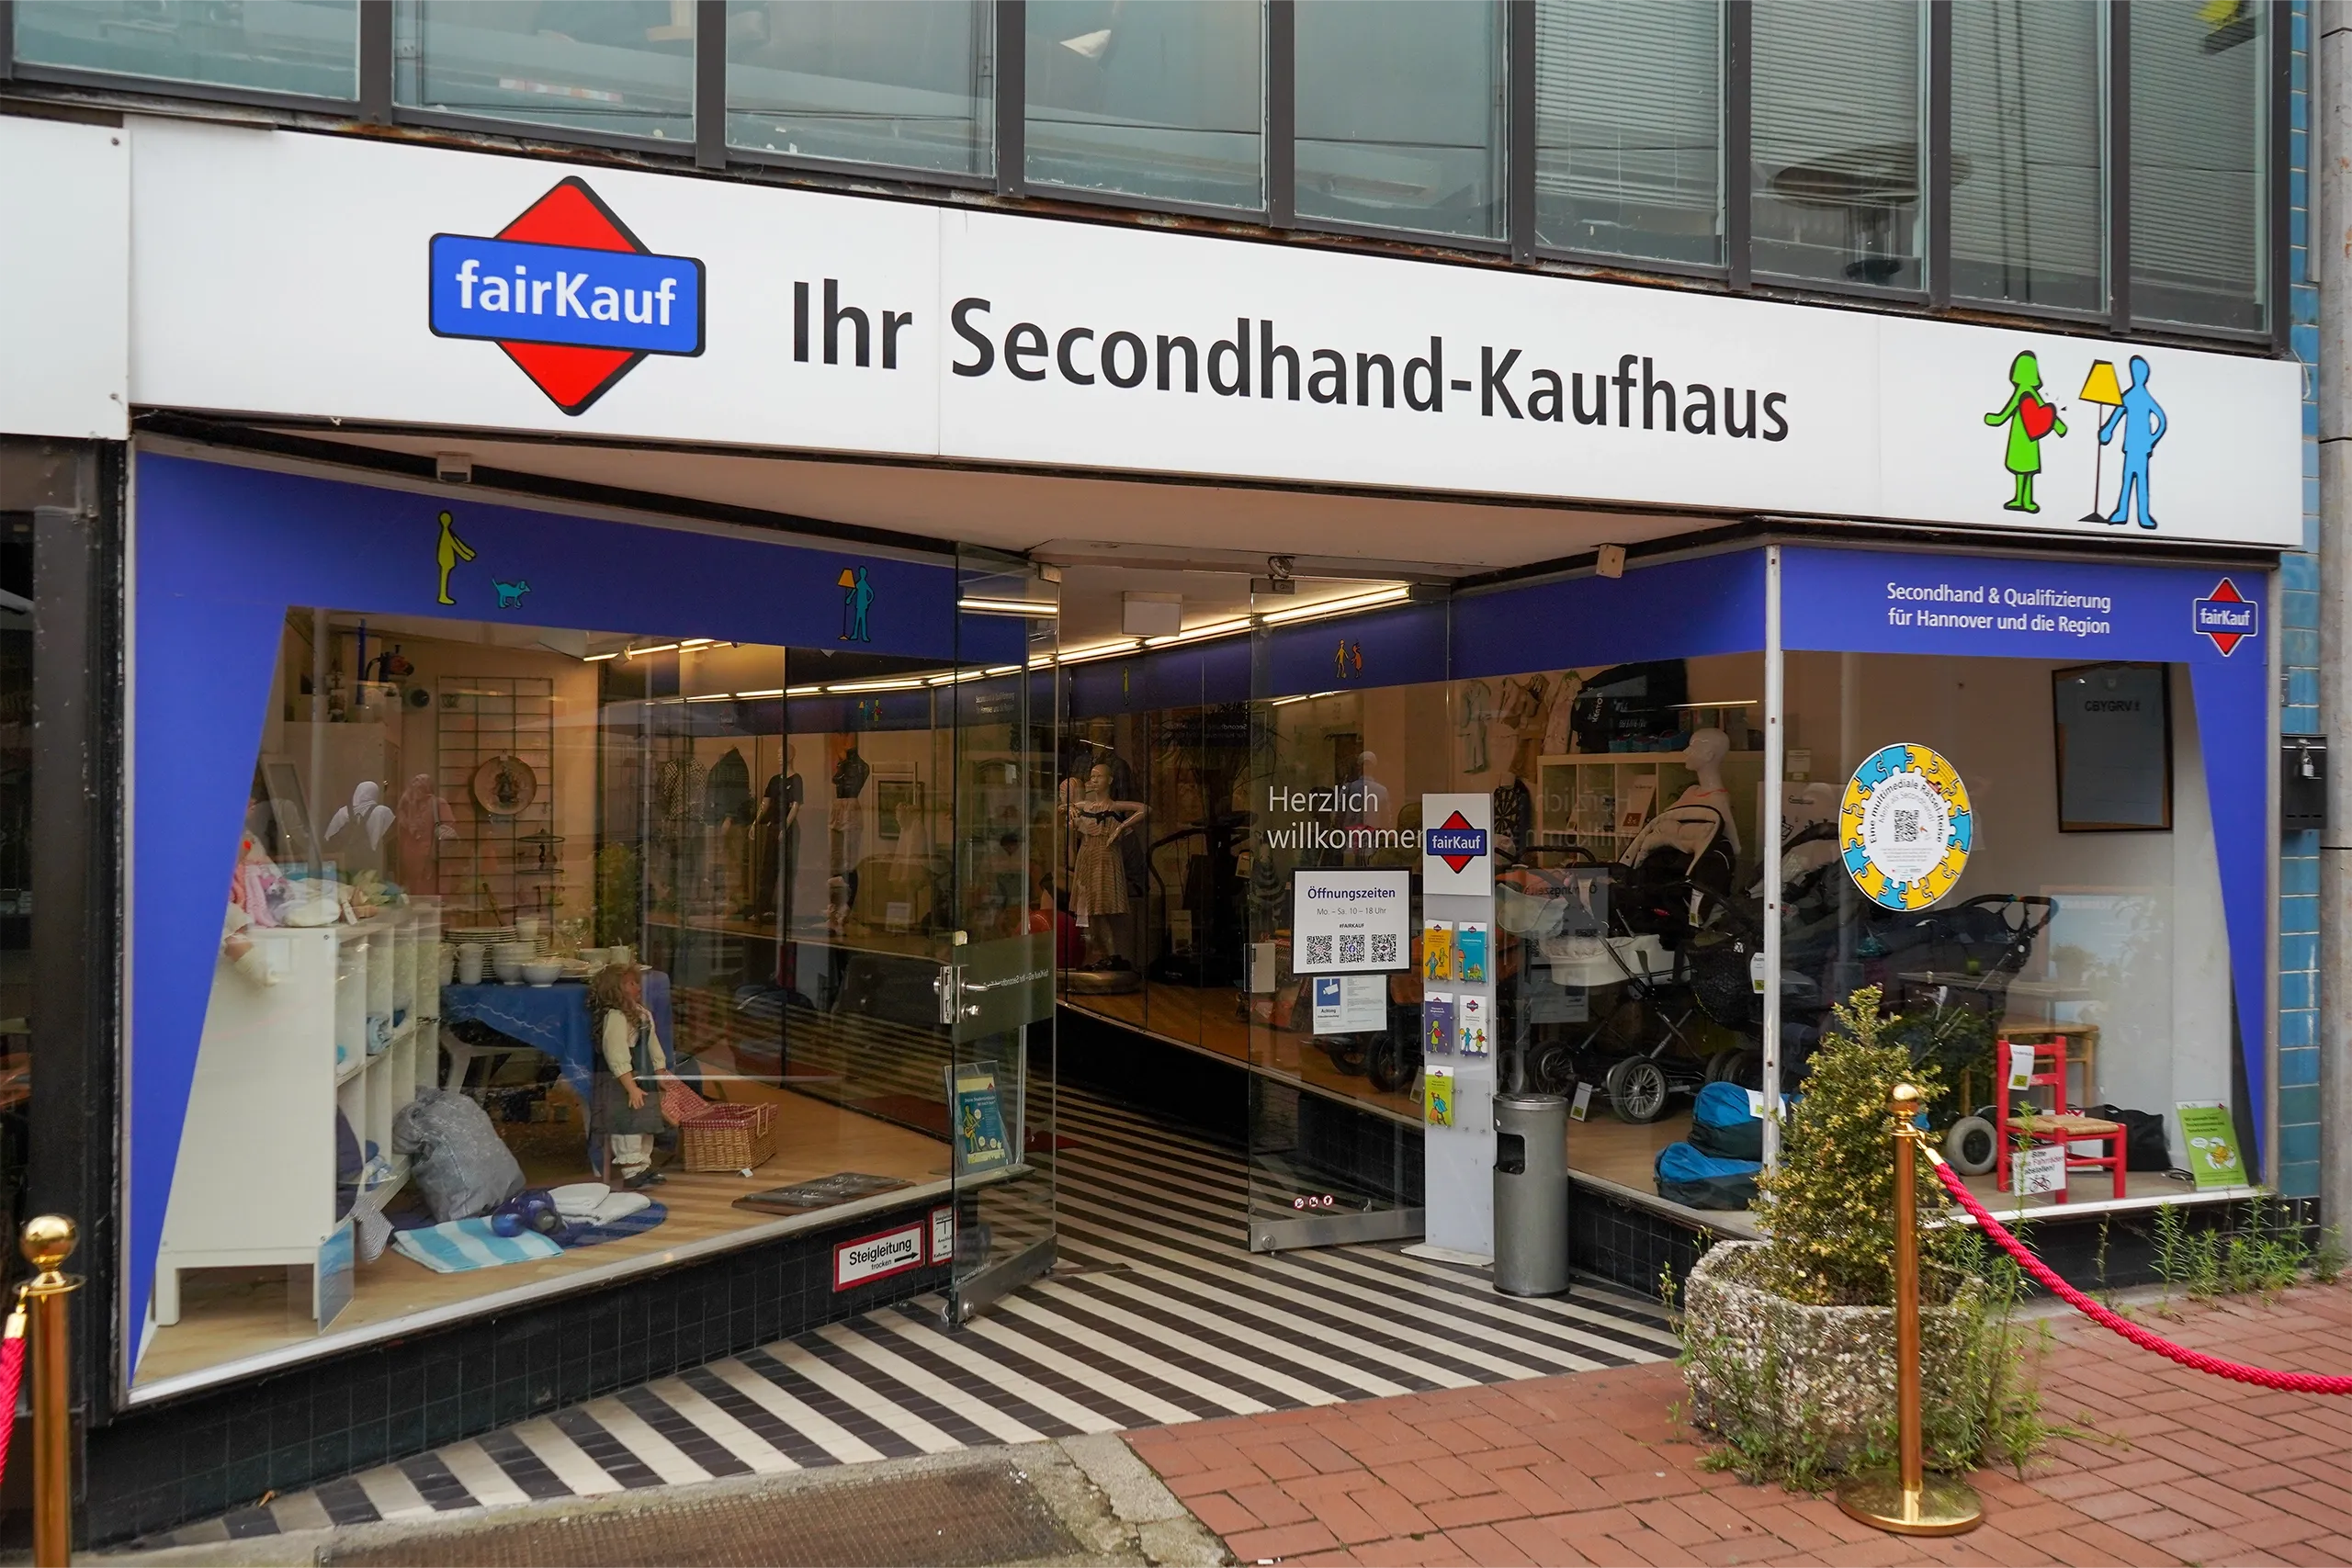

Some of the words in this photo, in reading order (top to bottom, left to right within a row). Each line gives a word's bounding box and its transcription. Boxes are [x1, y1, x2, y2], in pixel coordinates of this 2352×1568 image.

[456, 259, 677, 326] fairKauf
[794, 277, 912, 370] Ihr
[949, 296, 1790, 442] Secondhand-Kaufhaus
[1887, 581, 1984, 604] Secondhand
[1987, 586, 2001, 605] &
[2004, 588, 2111, 614] Qualifizierung
[1888, 607, 1914, 626] für
[1917, 610, 1994, 631] Hannover
[1996, 613, 2028, 633] und
[2030, 614, 2056, 633] die
[2058, 615, 2110, 636] Region
[2199, 607, 2251, 628] fairKauf
[1269, 785, 1378, 812] Herzlich
[1431, 835, 1480, 850] fairKauf
[1307, 886, 1396, 901] Öffnungszeiten
[1316, 907, 1329, 915] Mo.
[1337, 907, 1347, 915] Sa.
[1349, 907, 1358, 915] 10
[1364, 907, 1373, 915] 18
[849, 1236, 912, 1267] Steigleitung
[871, 1258, 892, 1271] trocken
